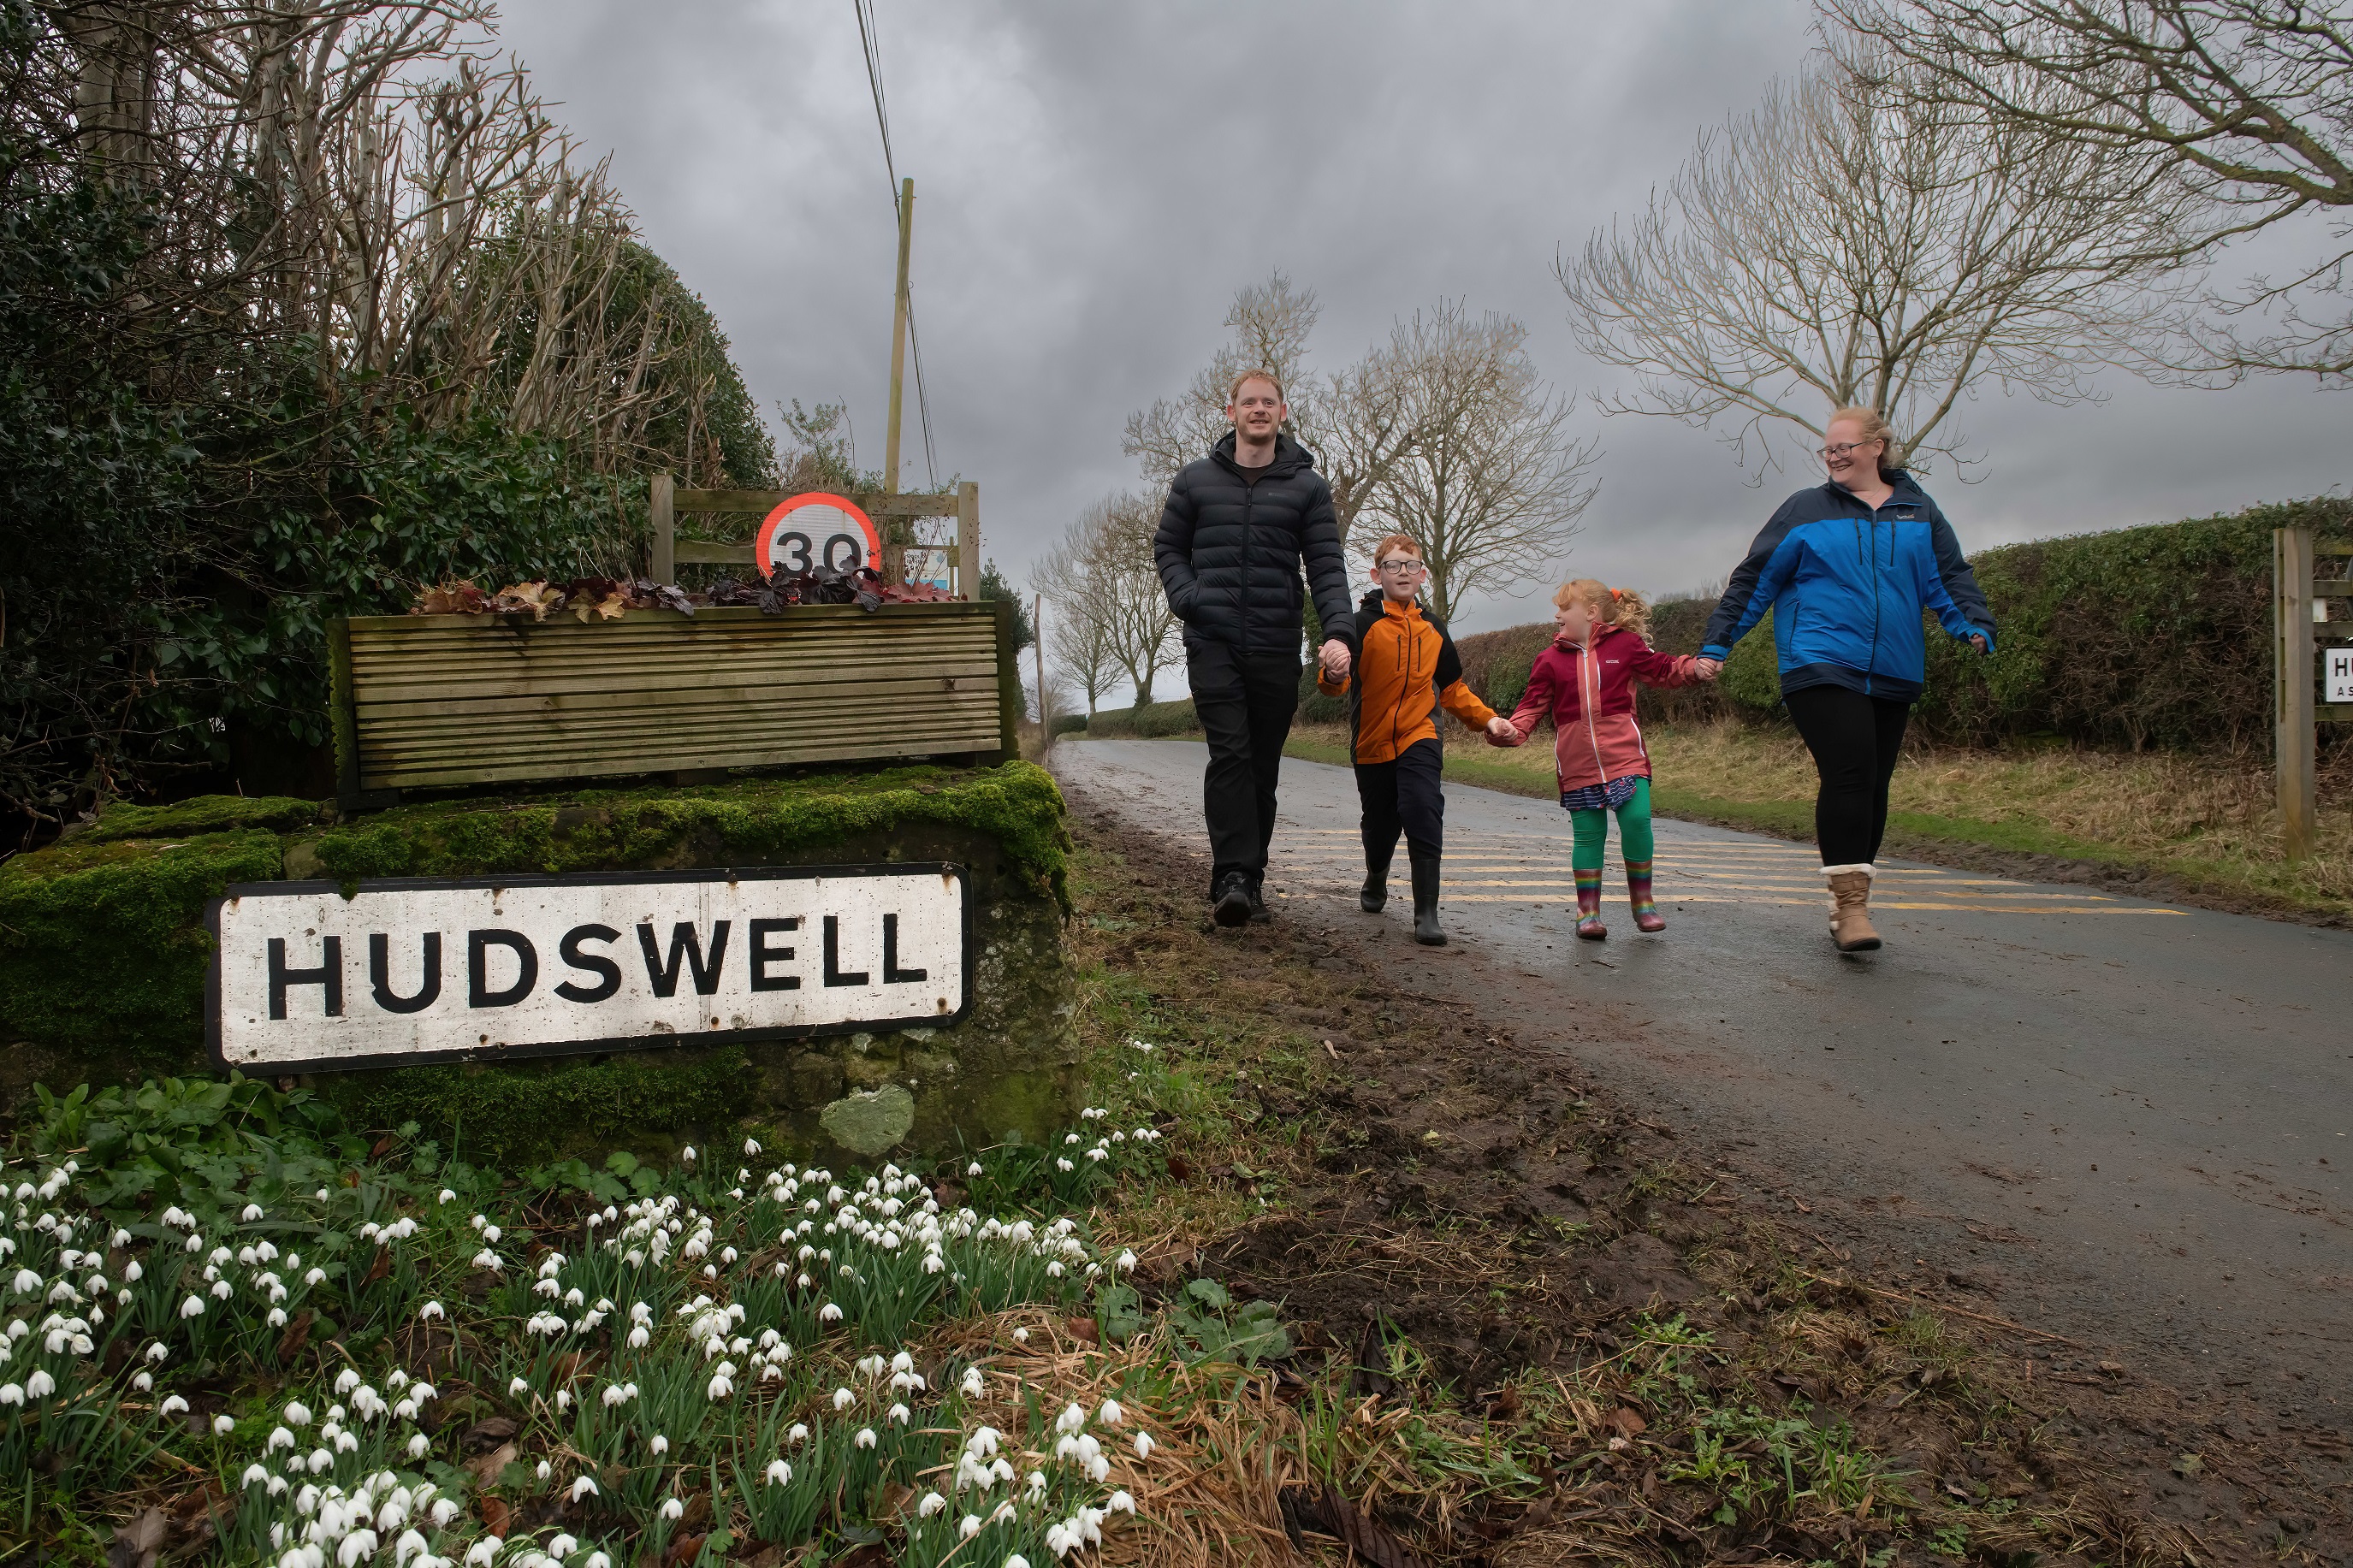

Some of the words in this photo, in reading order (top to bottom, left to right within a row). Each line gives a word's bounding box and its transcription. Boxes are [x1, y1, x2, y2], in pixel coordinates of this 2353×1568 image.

[777, 531, 862, 578] 30
[2335, 657, 2353, 677] H
[268, 913, 927, 1021] HUDSWELL
